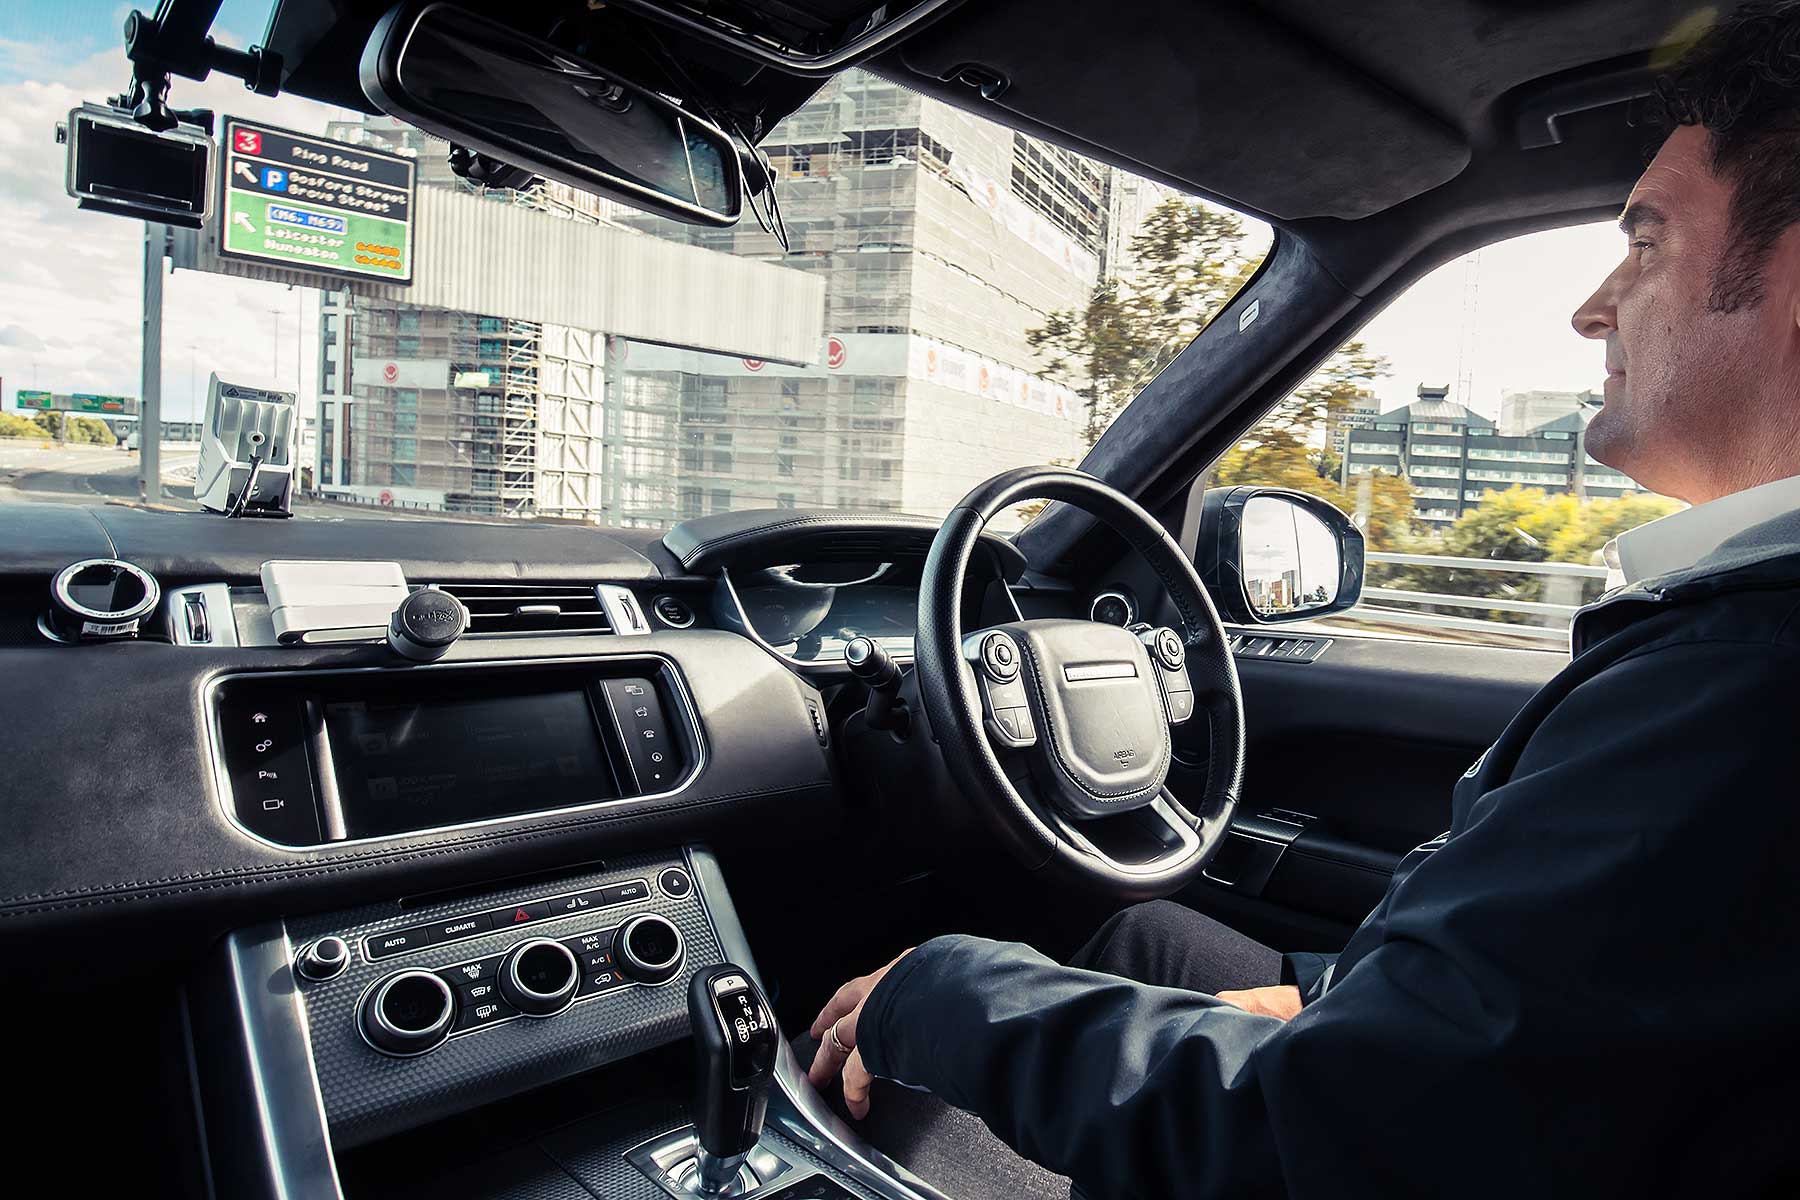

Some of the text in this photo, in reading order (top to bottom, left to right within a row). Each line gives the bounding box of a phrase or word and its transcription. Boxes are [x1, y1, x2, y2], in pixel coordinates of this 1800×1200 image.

[239, 131, 257, 152] 3
[291, 146, 369, 172] Ring Road
[266, 170, 283, 188] P
[288, 171, 407, 205] Gosford Street
[287, 183, 391, 213] Grove Street
[263, 225, 344, 247] Leicester
[263, 238, 339, 260] Nuneaton
[621, 887, 637, 896] AUTO
[445, 921, 476, 934] CLIMATE
[384, 937, 406, 948] AUTO
[582, 935, 599, 945] MAX
[586, 942, 600, 951] A/C
[591, 956, 606, 965] A/C
[462, 963, 482, 974] MAX
[738, 995, 748, 1005] R
[743, 1006, 753, 1017] N
[749, 1020, 758, 1032] D
